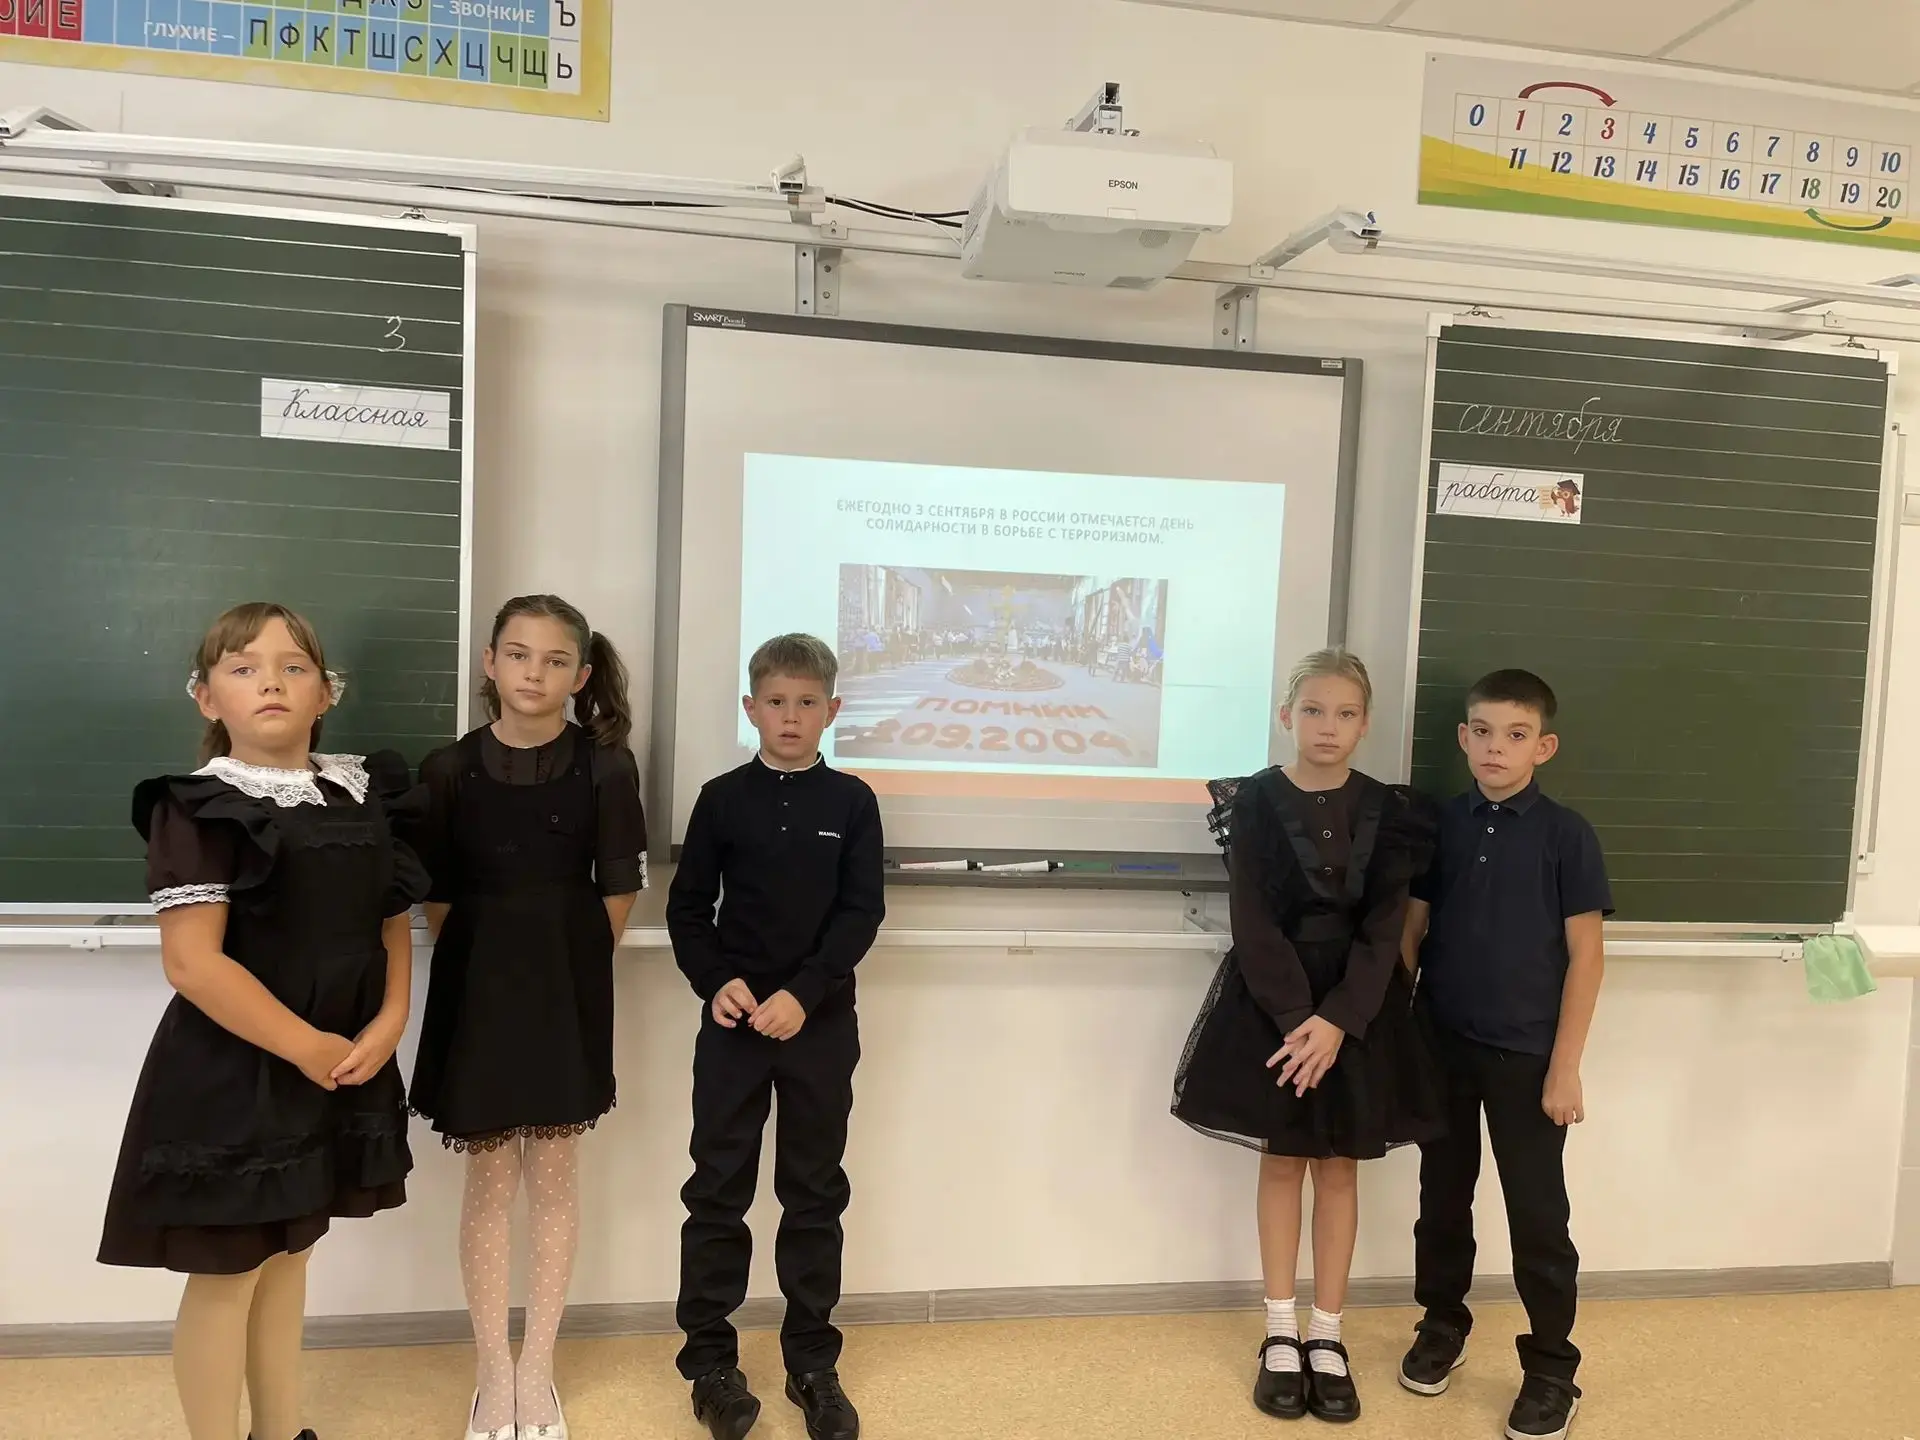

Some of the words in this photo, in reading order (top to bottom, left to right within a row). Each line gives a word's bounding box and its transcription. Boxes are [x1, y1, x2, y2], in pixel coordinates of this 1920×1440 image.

[449, 1, 536, 24] ЗВОНКИЕ
[143, 21, 218, 42] ГЛУХИЕ
[1468, 103, 1485, 127] 0
[1515, 109, 1526, 131] 1
[1558, 113, 1573, 137] 2
[1600, 117, 1615, 140] 3
[1643, 121, 1658, 145] 4
[1684, 127, 1699, 149] 5
[1726, 131, 1740, 154] 6
[1766, 136, 1780, 158] 7
[1806, 141, 1820, 163] 8
[1845, 146, 1859, 167] 9
[1880, 151, 1901, 173] 10
[1108, 179, 1138, 190] EPSON
[1508, 147, 1527, 170] 11
[1550, 151, 1573, 174] 12
[1593, 155, 1616, 178] 13
[1636, 159, 1658, 183] 14
[1678, 164, 1700, 187] 15
[1719, 168, 1740, 190] 16
[1760, 173, 1782, 195] 17
[1800, 177, 1821, 200] 18
[1840, 182, 1860, 204] 19
[1875, 186, 1902, 210] 20
[377, 315, 406, 353] 3
[283, 388, 429, 428] Классная
[1458, 396, 1624, 455] сентября
[1440, 472, 1540, 508] работа
[836, 498, 912, 516] ЕЖЕГОДНО
[928, 504, 995, 520] СЕНТЯБРЯ
[999, 508, 1008, 520] В
[1012, 508, 1066, 524] РОССИИ
[1070, 512, 1156, 529] ОТМЕЧАЕТСЯ
[1159, 516, 1195, 531] ДЕНЬ
[866, 517, 977, 535] СОЛИДАРНОСТИ
[981, 524, 990, 536] В
[993, 524, 1044, 540] БОРЬБЕ
[1047, 527, 1057, 540] С
[1060, 528, 1165, 545] ТЕРРОРИЗМОМ.
